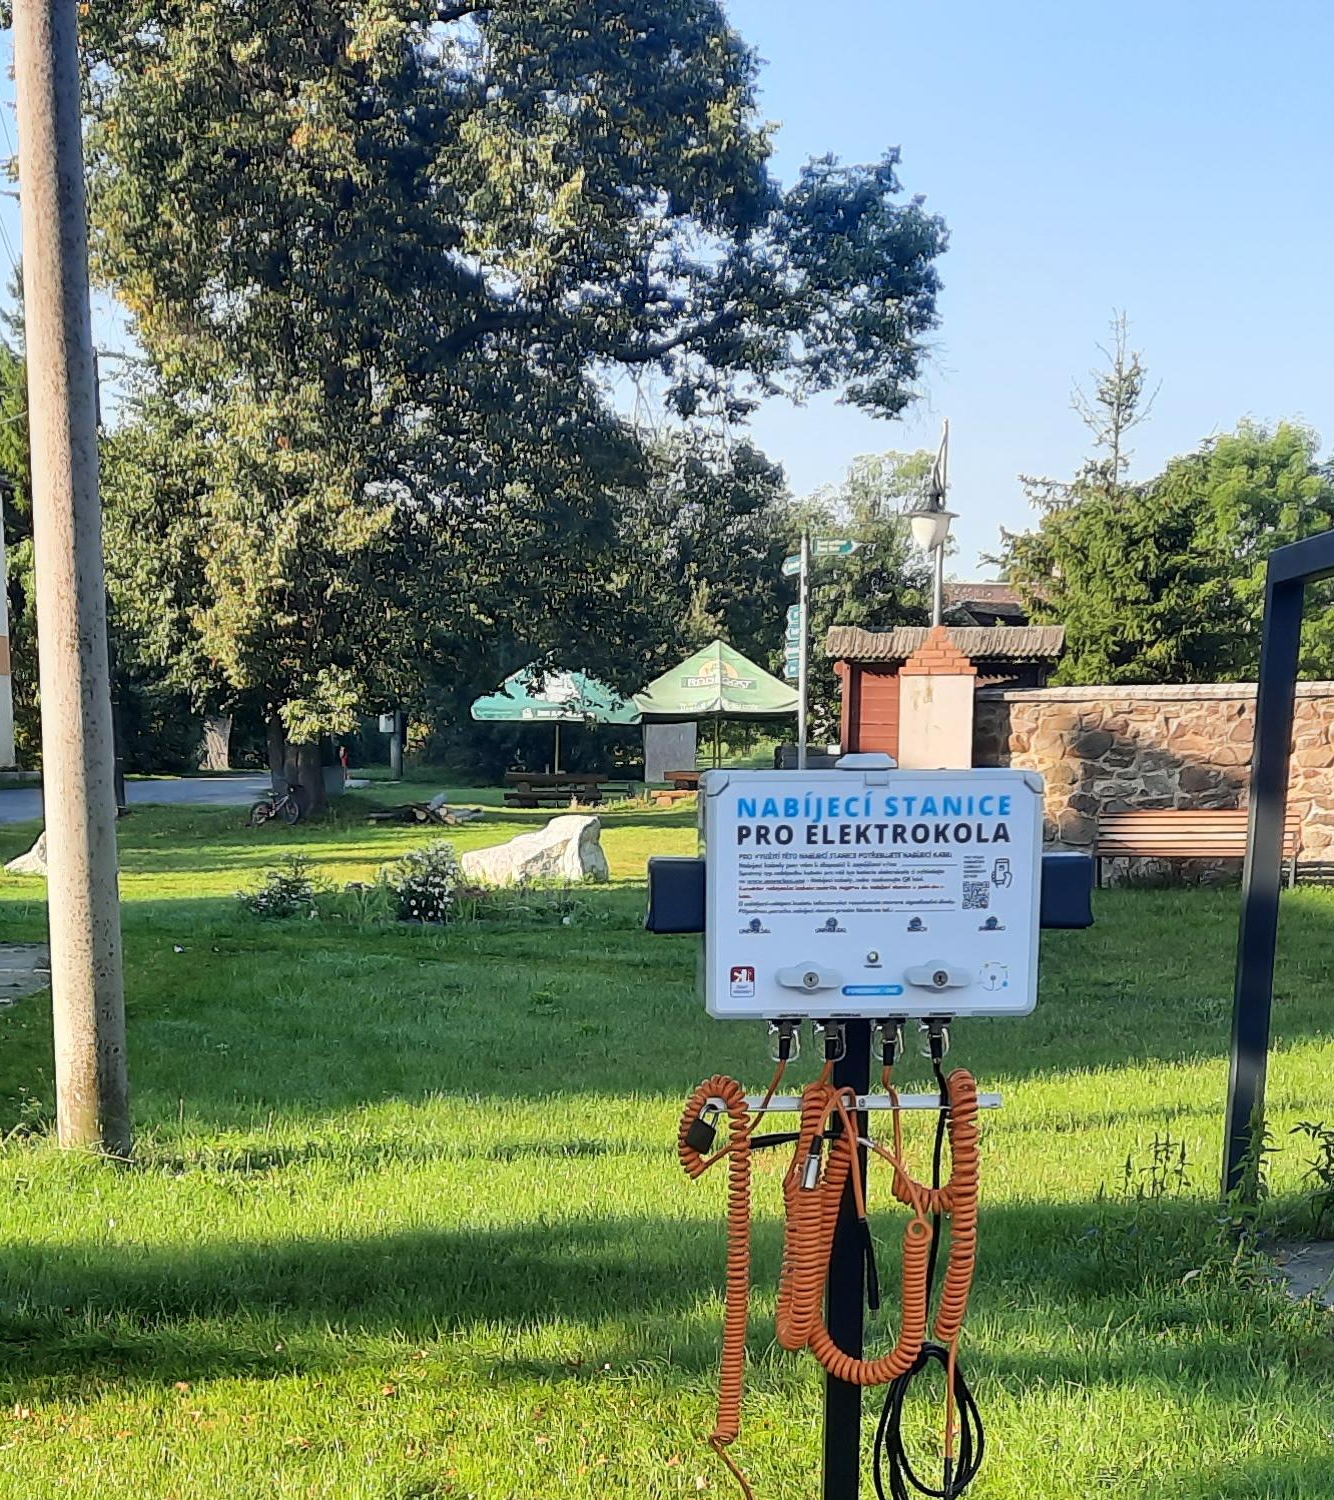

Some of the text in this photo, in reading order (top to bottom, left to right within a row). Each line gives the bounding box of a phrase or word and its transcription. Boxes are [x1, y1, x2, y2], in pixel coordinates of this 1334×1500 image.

[737, 791, 1012, 823] NABÍJECÍ STANICE
[736, 822, 1012, 846] PRO ELEKTROKOLA
